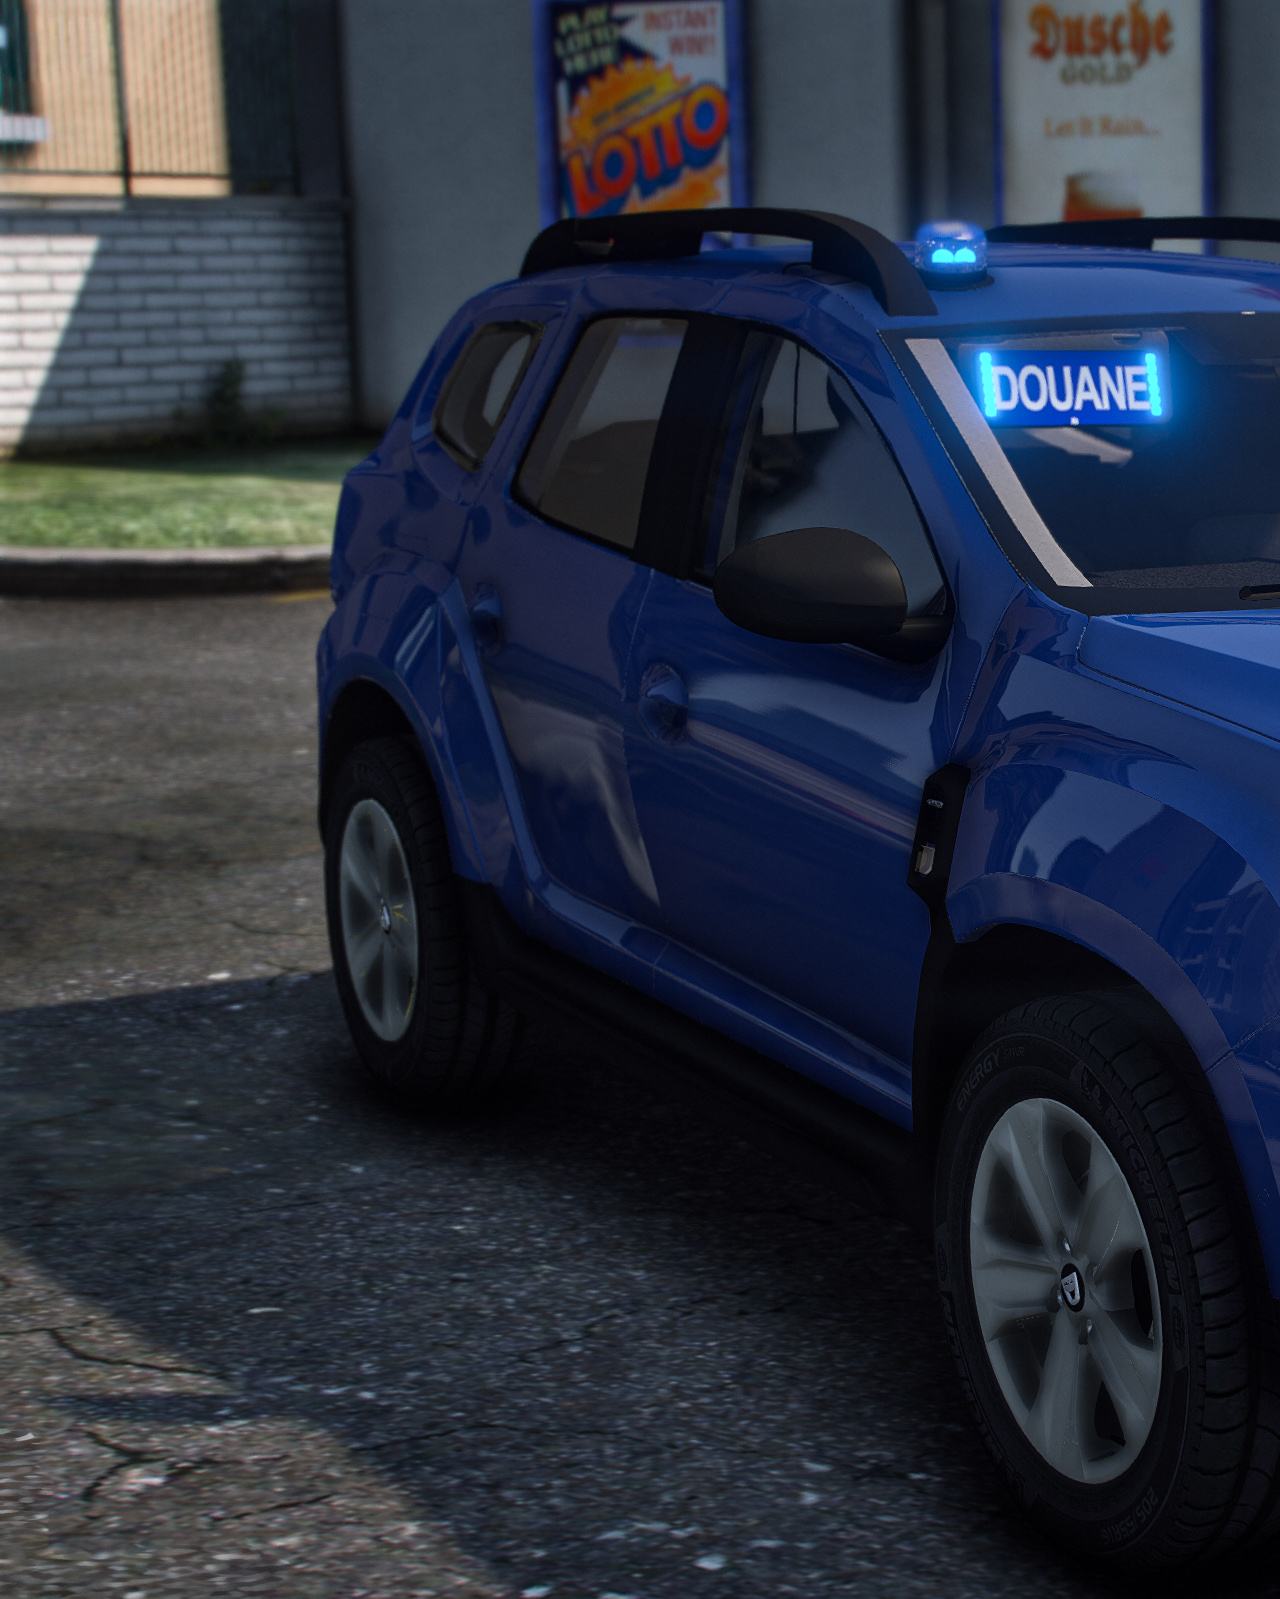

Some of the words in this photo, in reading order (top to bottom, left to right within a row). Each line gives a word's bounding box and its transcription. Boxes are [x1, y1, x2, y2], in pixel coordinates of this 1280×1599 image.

[644, 6, 718, 31] INSTANT
[1028, 1, 1174, 69] Dusche
[1059, 59, 1133, 86] GOLD
[567, 84, 730, 218] LOTTO
[991, 364, 1151, 412] DOUANE
[957, 1048, 1001, 1112] ENERGY
